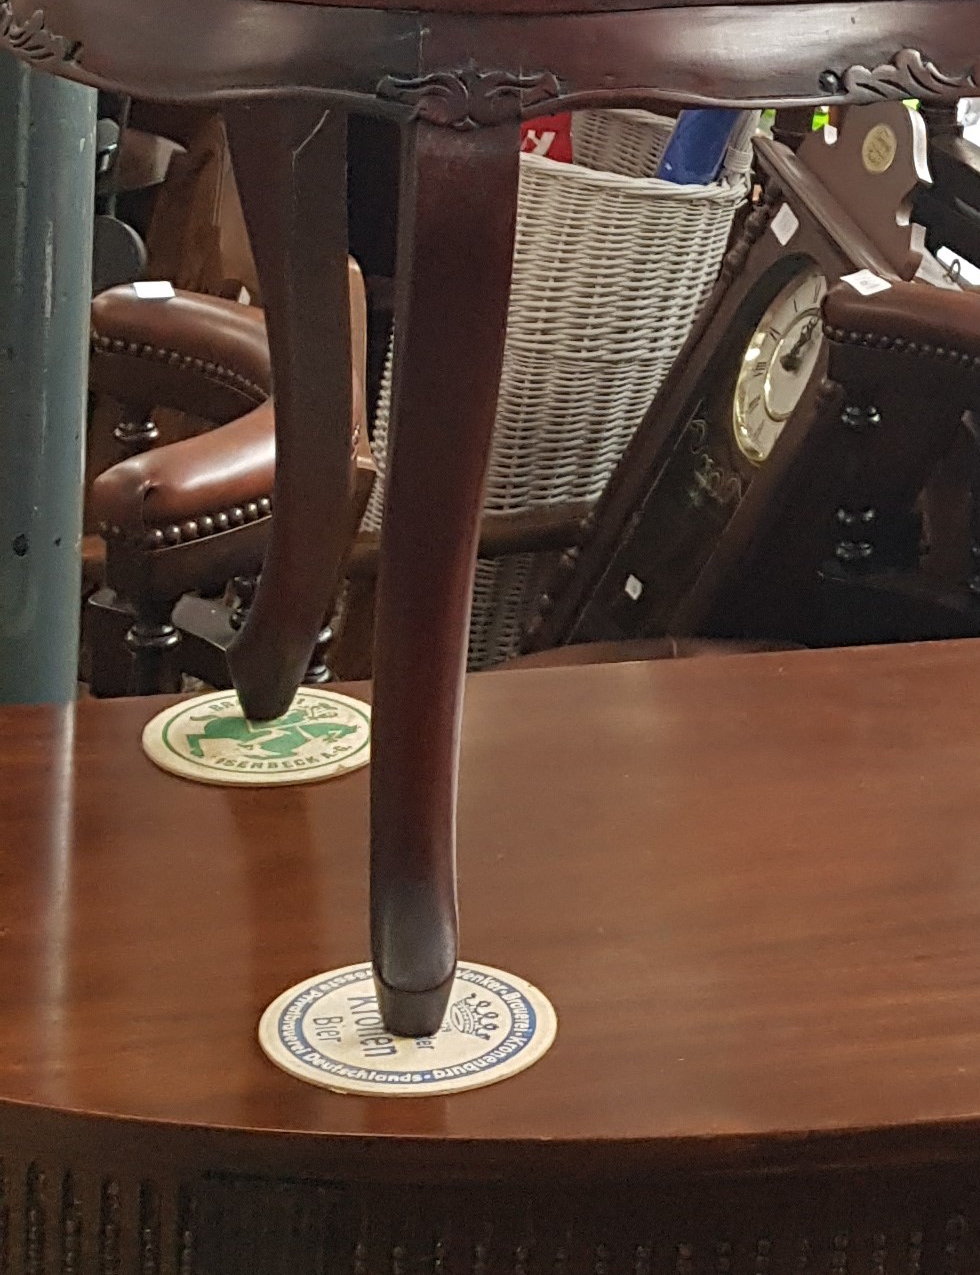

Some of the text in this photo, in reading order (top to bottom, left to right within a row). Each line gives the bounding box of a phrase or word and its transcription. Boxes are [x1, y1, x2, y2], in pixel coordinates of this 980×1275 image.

[213, 755, 320, 771] ISENBECK
[312, 1015, 344, 1044] Bier
[303, 1051, 423, 1083] Deutschlands
[432, 1035, 528, 1081] Kronenburg
